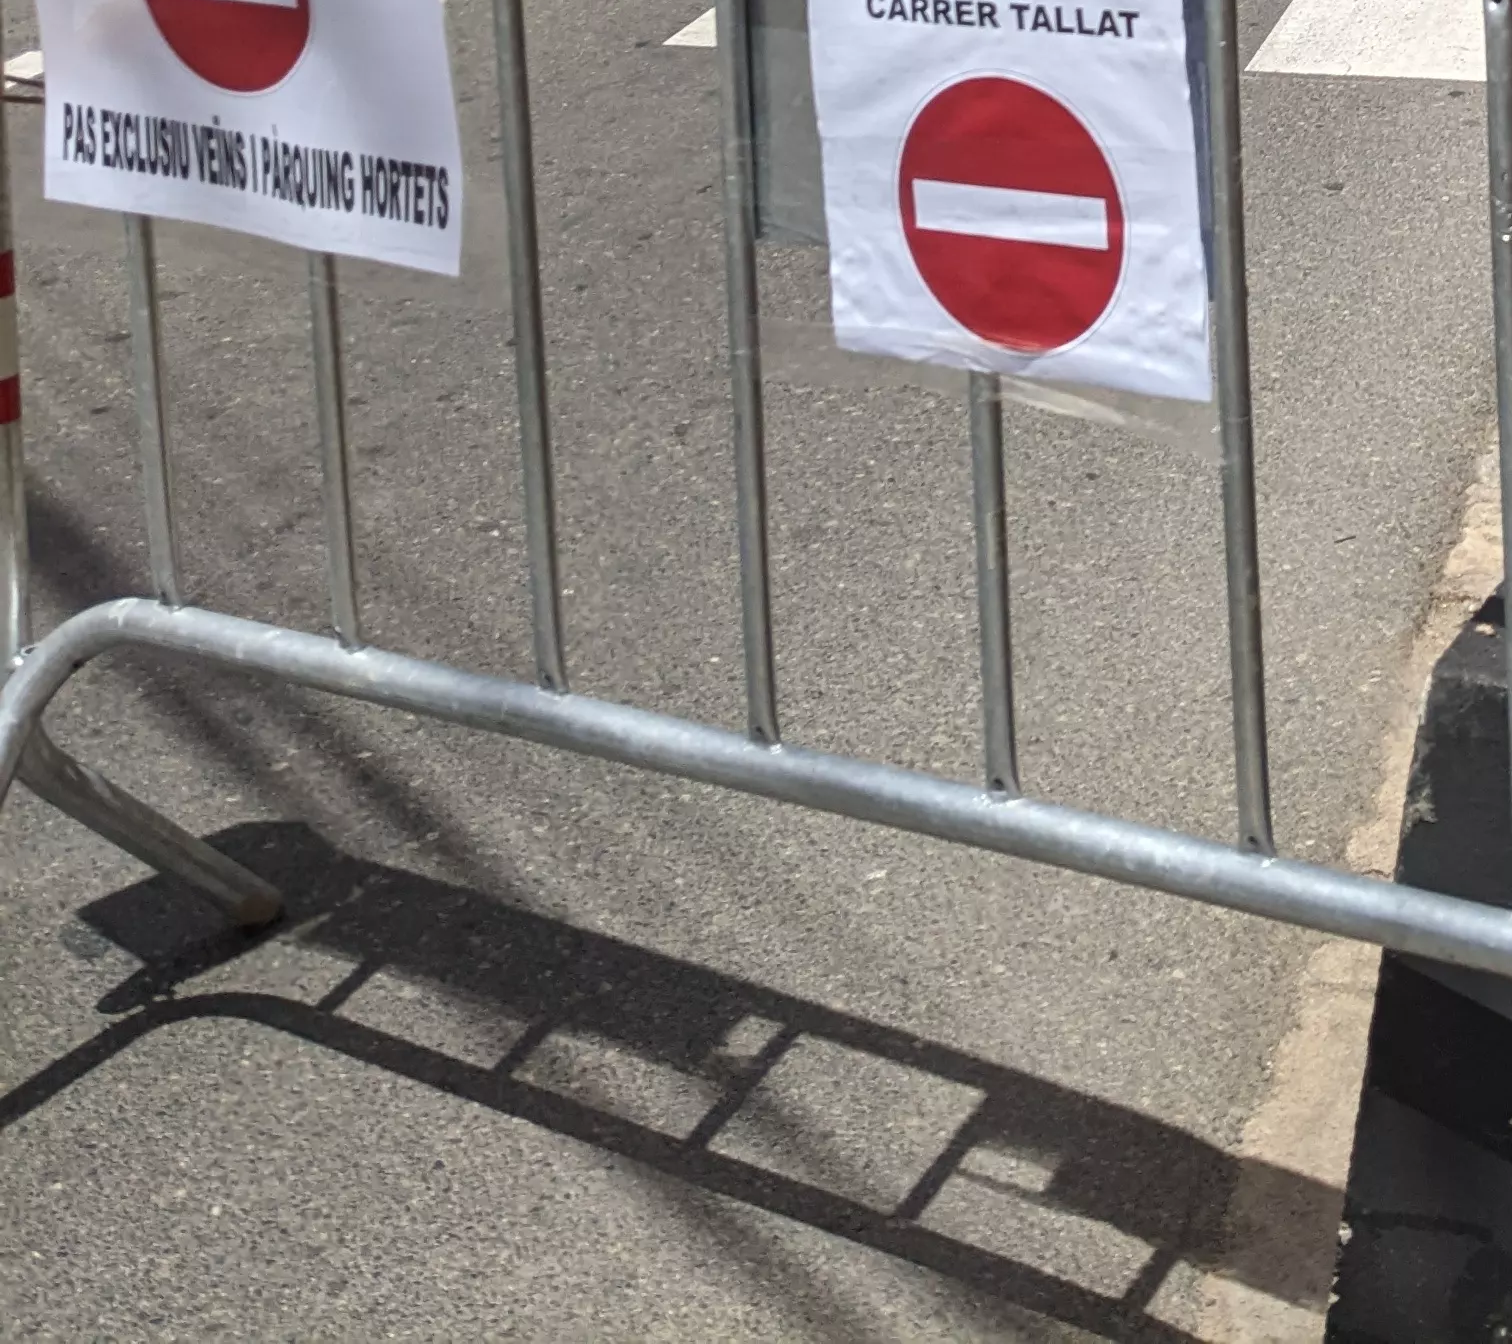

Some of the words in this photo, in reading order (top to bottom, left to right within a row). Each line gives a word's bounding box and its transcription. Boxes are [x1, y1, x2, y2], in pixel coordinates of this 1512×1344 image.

[1010, 1, 1140, 39] TALLAT
[62, 102, 96, 166] PAS
[100, 108, 190, 180] EXCLUSIU
[250, 134, 258, 193] I
[360, 154, 448, 229] HORTETS
